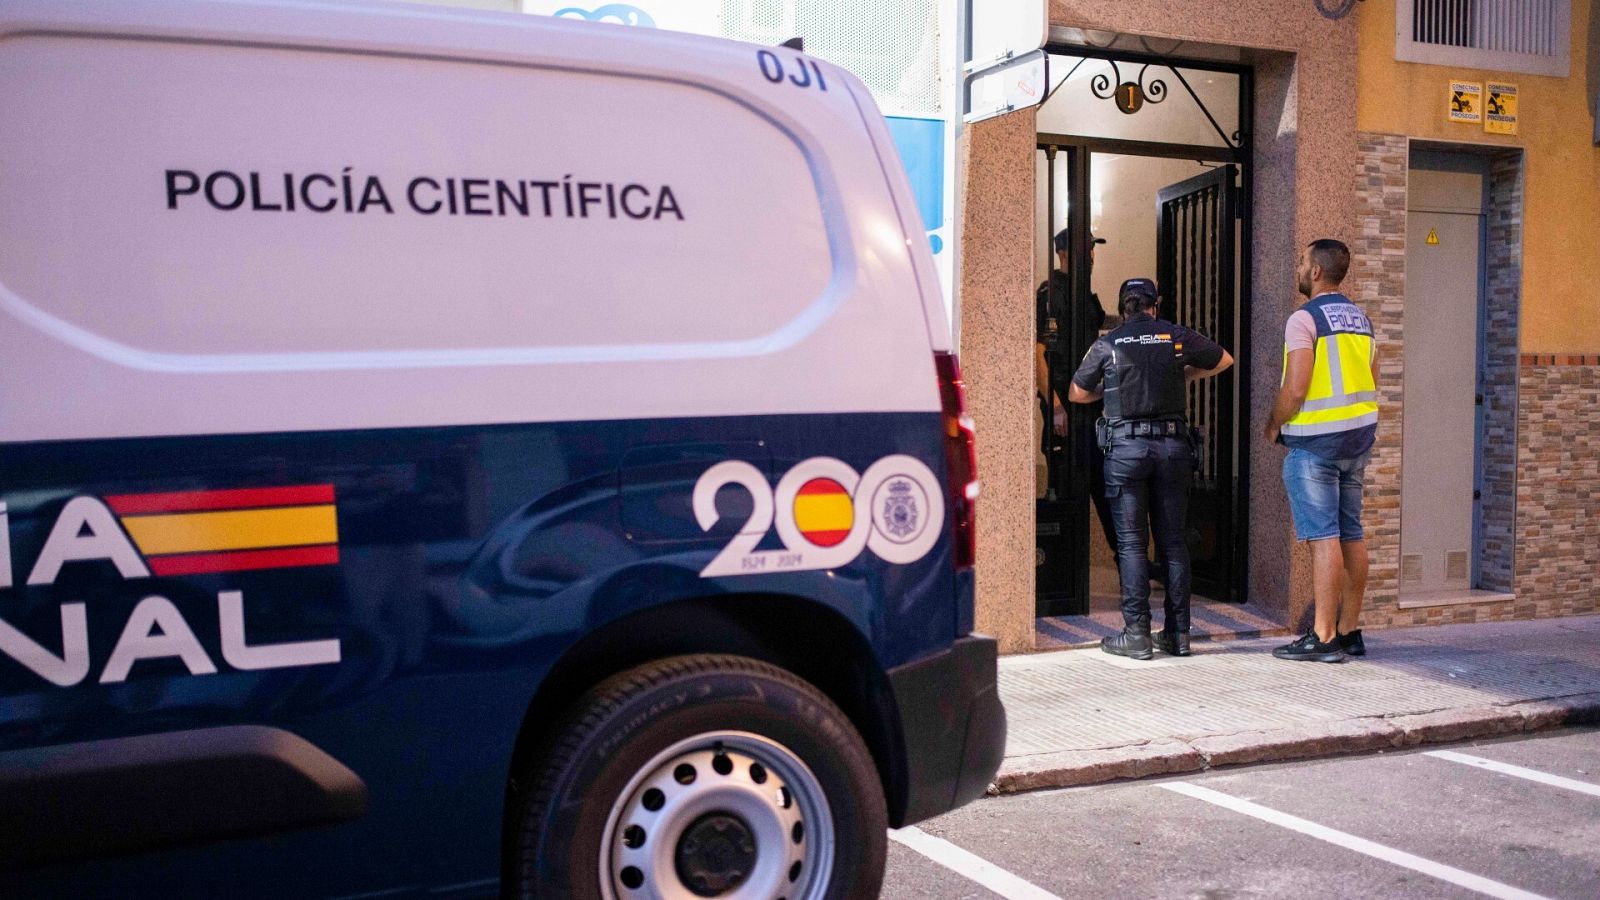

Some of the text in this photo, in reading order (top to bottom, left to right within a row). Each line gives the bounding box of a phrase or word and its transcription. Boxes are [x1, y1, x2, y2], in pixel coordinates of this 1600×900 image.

[1127, 86, 1136, 109] 1
[1487, 114, 1516, 123] PROSEGUR
[165, 167, 684, 221] POLICÍA CIENTÍFICA
[1115, 334, 1159, 345] POLICIA
[693, 454, 945, 577] 200
